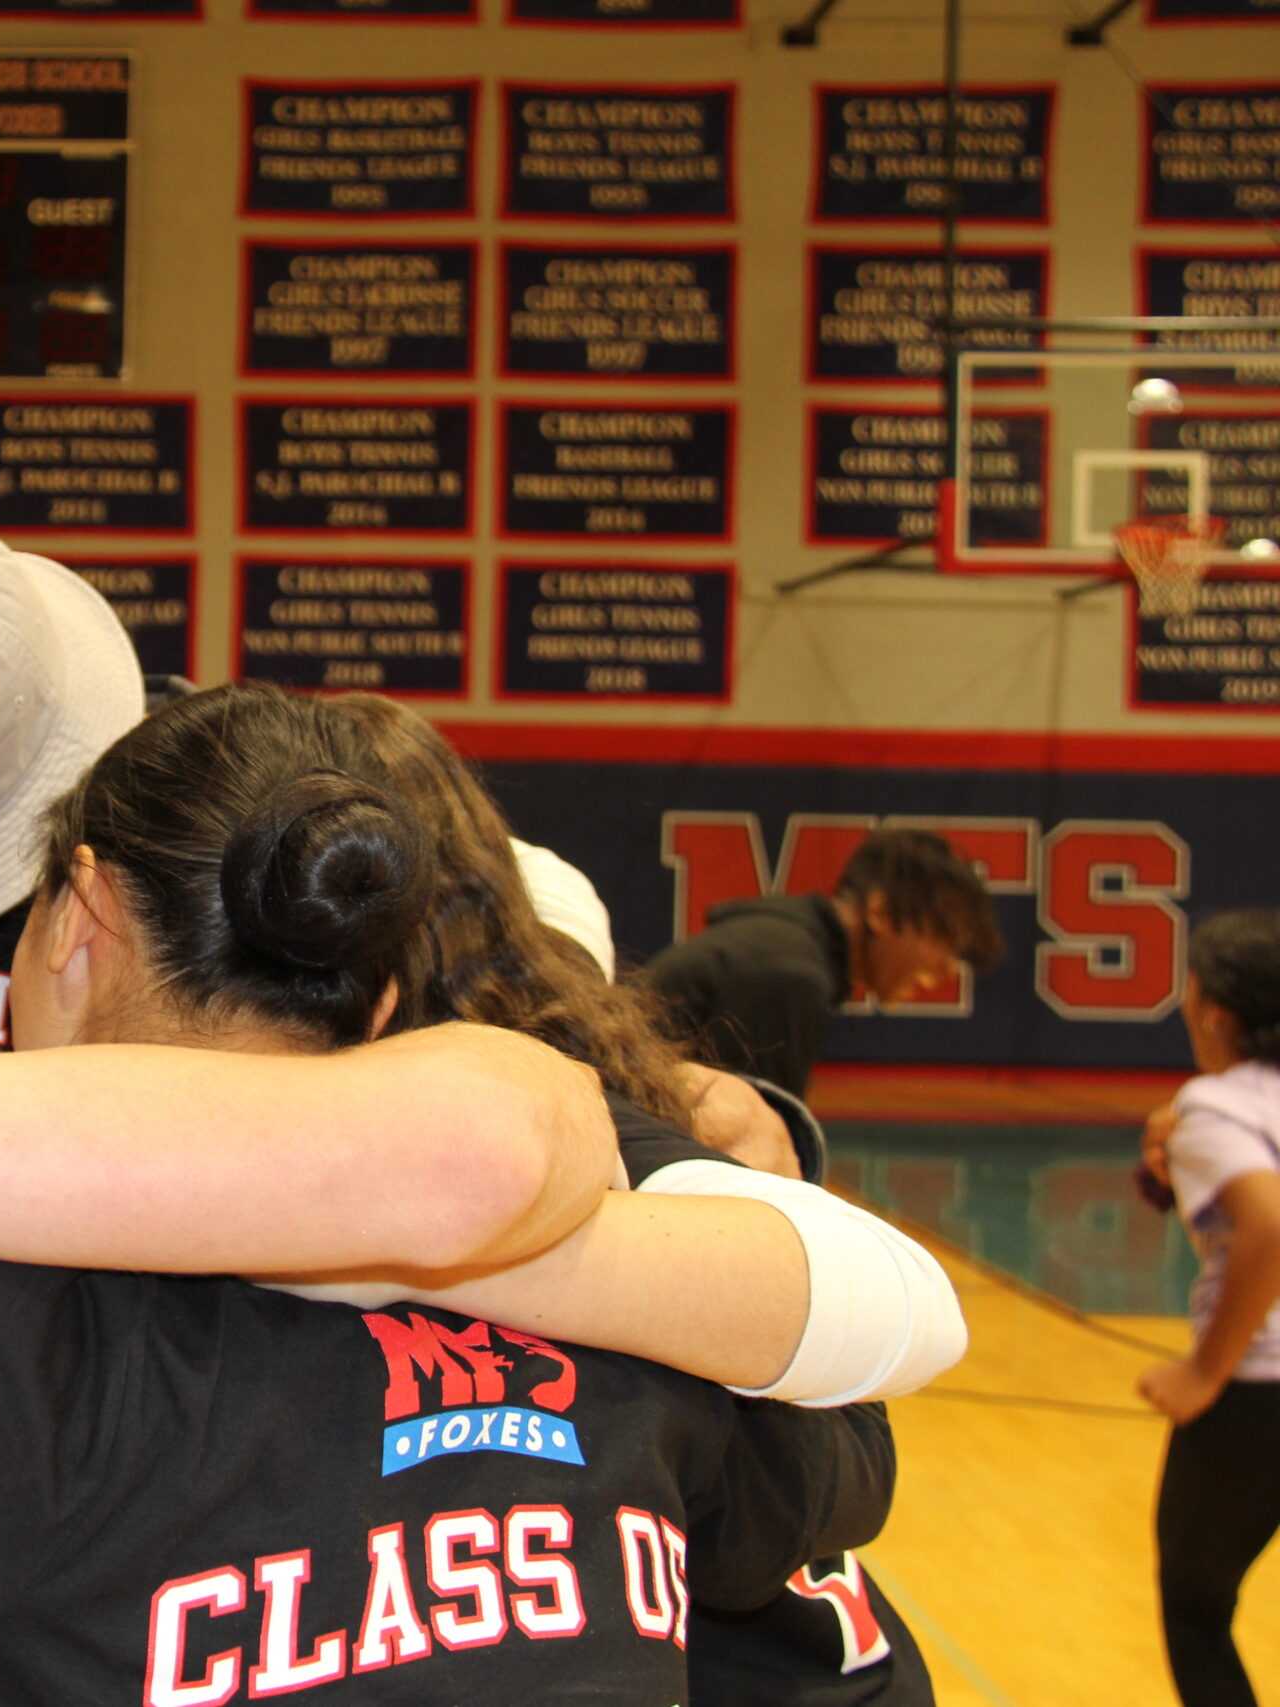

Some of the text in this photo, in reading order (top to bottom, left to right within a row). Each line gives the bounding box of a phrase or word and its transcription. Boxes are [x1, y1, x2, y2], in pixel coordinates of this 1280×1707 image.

[272, 96, 453, 123] CHAMPION
[523, 101, 704, 128] CHAMPION
[927, 132, 1022, 152] TNNIS
[876, 156, 1013, 180] PAROHIAL
[28, 198, 112, 225] GUEST
[289, 256, 438, 280] CHAMPION
[546, 261, 695, 286] CHAMPION
[857, 263, 1007, 290] CHAMION
[916, 290, 1030, 318] LAROSSE
[3, 407, 152, 432] CHAMPION
[282, 409, 434, 435] CHAMPION
[539, 413, 692, 439] CHAMPION
[852, 417, 1007, 444] CHAMON
[278, 568, 430, 594] CHAMPION
[539, 572, 693, 599] CHAMPION
[417, 1414, 545, 1460] FOXES
[143, 1504, 587, 1707] CLASS
